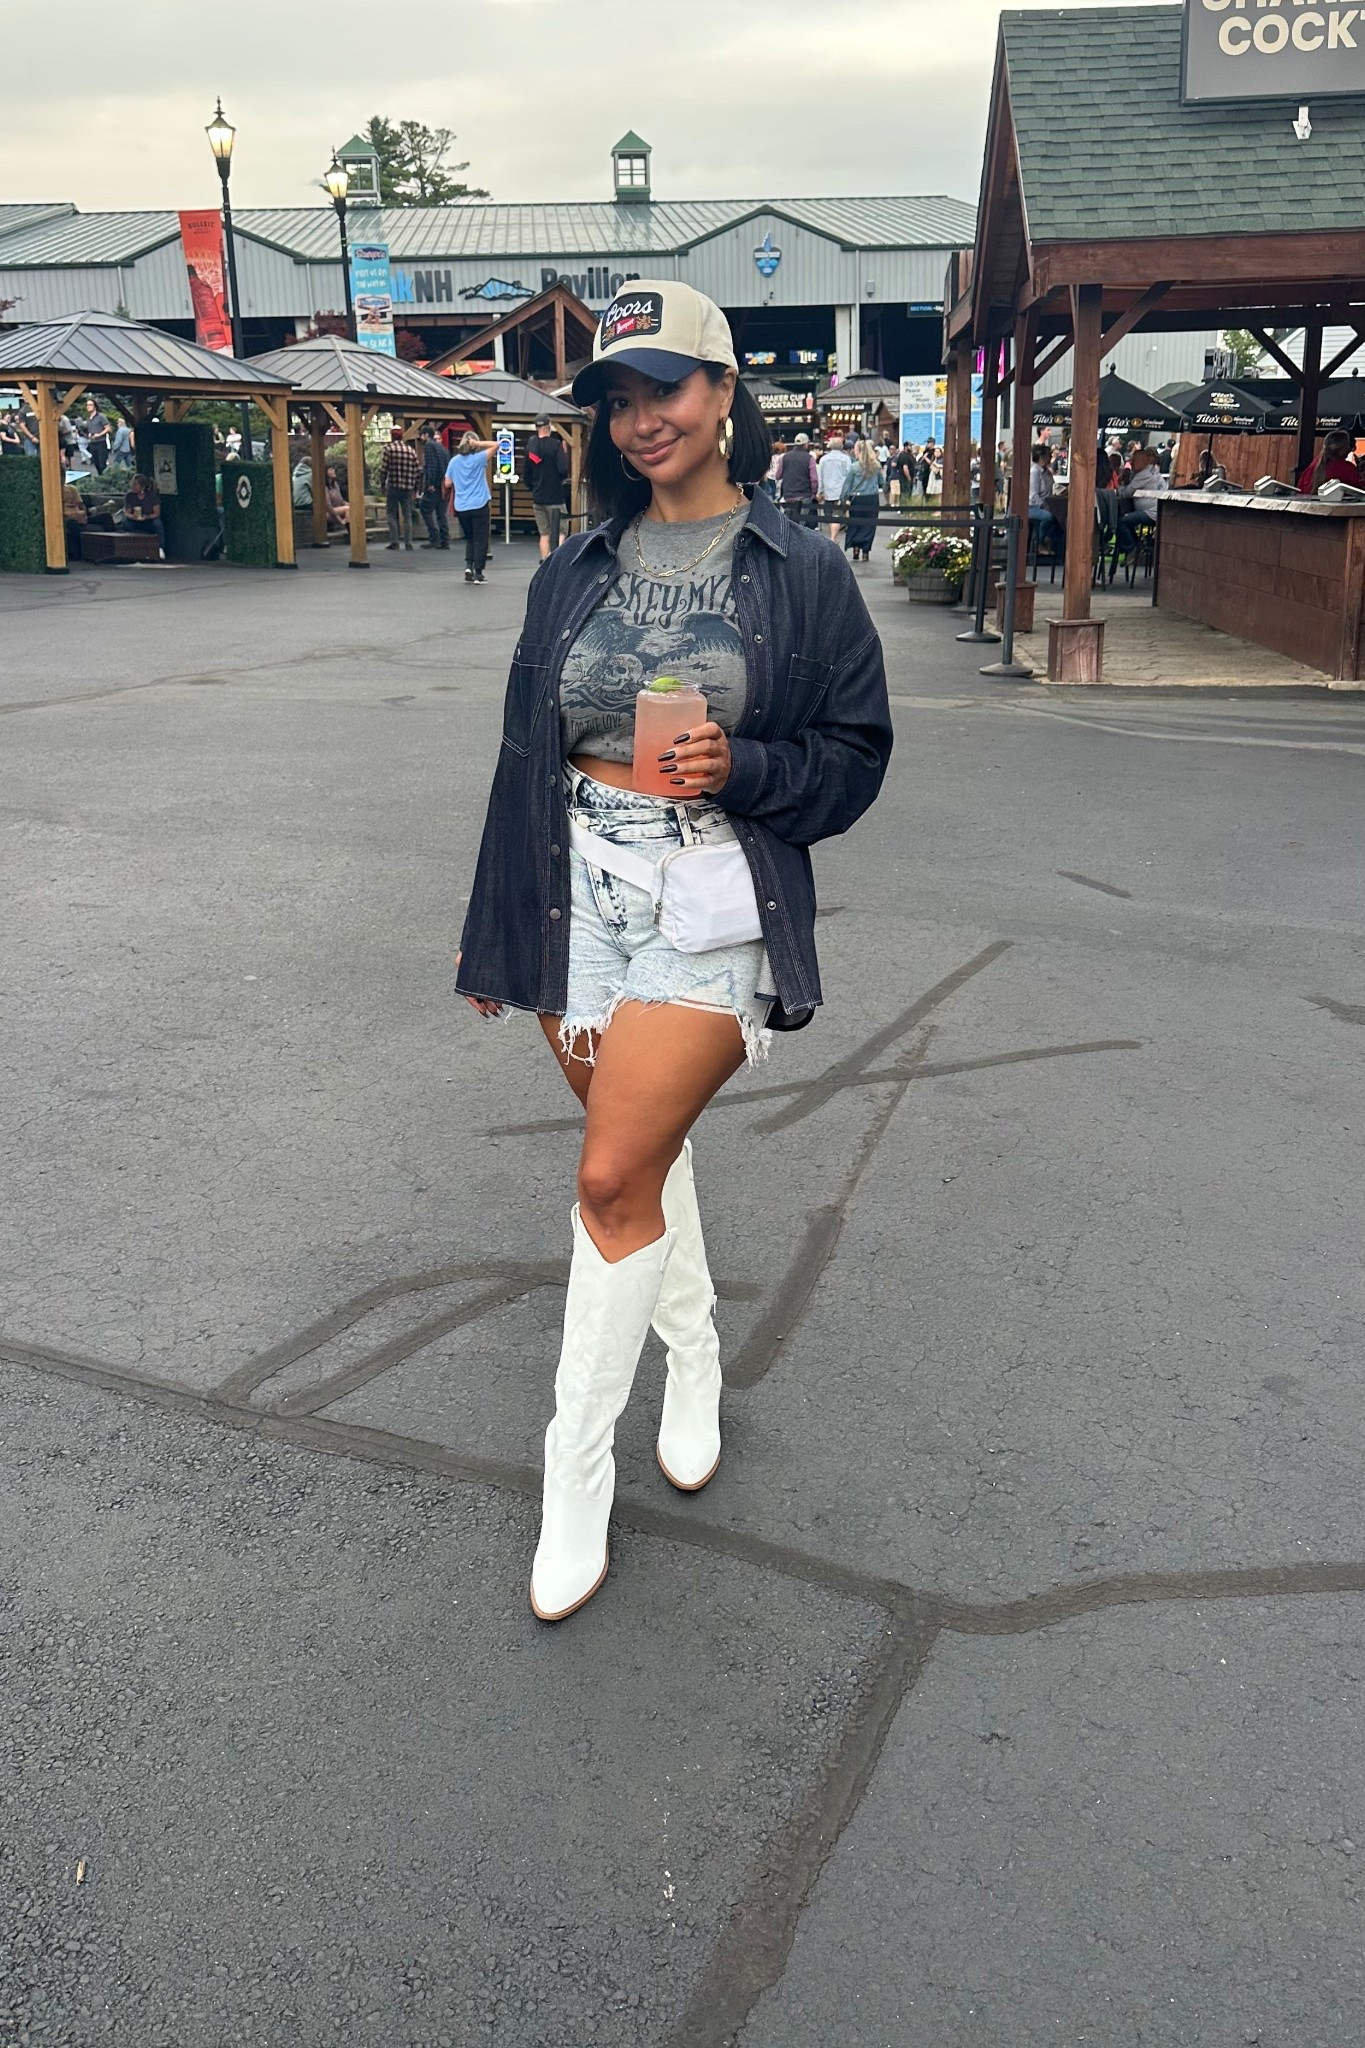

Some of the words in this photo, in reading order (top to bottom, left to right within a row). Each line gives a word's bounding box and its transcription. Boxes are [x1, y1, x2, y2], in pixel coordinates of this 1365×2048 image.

[1218, 10, 1365, 56] COCK
[605, 300, 654, 327] Coors
[797, 350, 817, 364] Lite
[758, 394, 789, 402] SHAKER
[789, 393, 806, 401] CUP
[760, 401, 804, 409] COCKTAILS
[1033, 414, 1053, 424] Tito's
[1106, 417, 1130, 427] Tito's
[1196, 413, 1220, 424] Tito's
[584, 717, 599, 735] THE
[602, 713, 623, 730] LOVE
